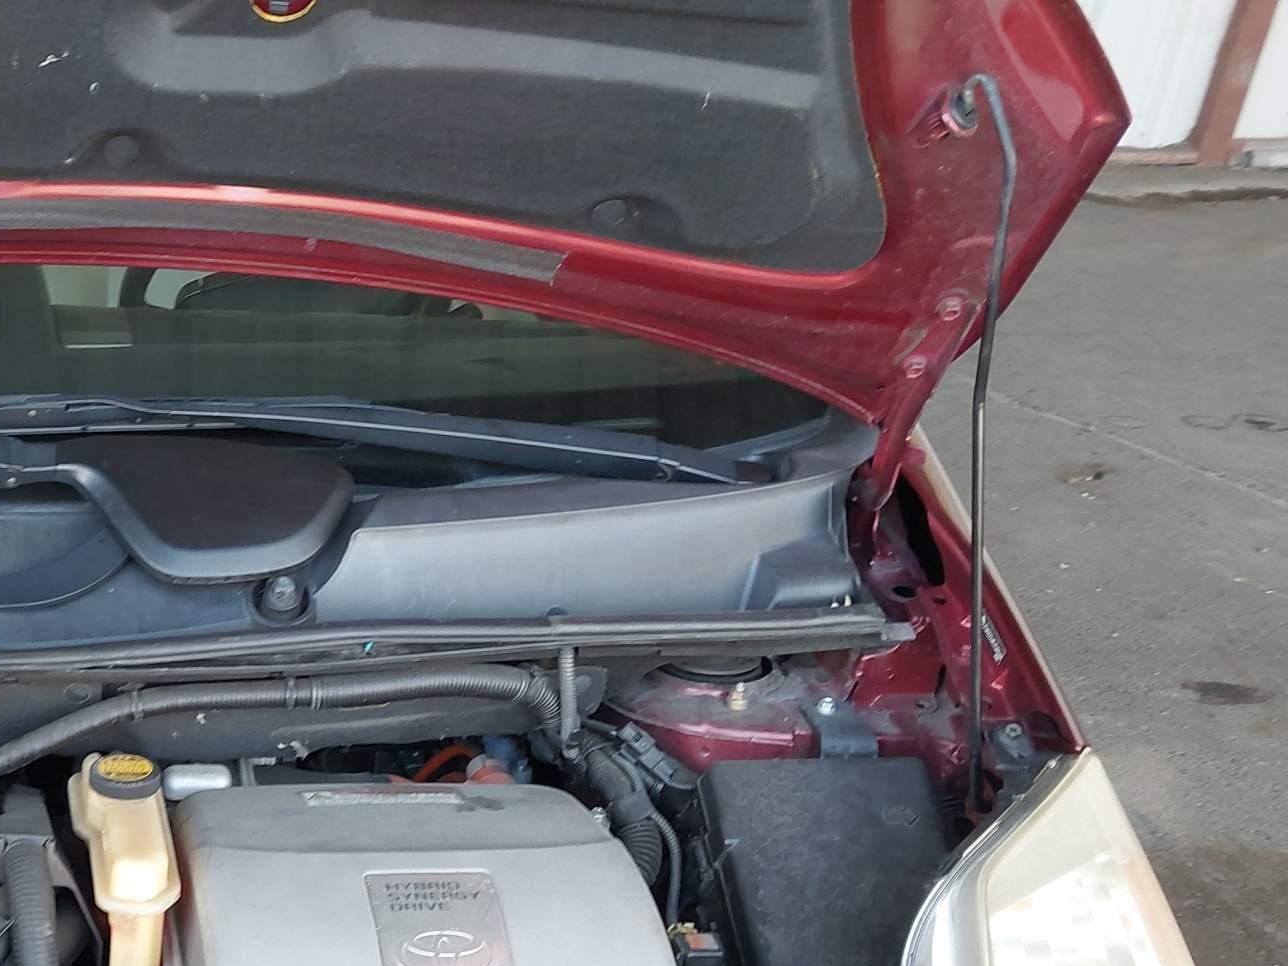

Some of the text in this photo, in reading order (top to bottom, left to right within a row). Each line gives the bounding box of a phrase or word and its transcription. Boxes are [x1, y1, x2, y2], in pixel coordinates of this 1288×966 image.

[384, 881, 461, 891] HYBRID
[386, 891, 481, 901] SYNERGY
[389, 901, 450, 912] DRIVE
